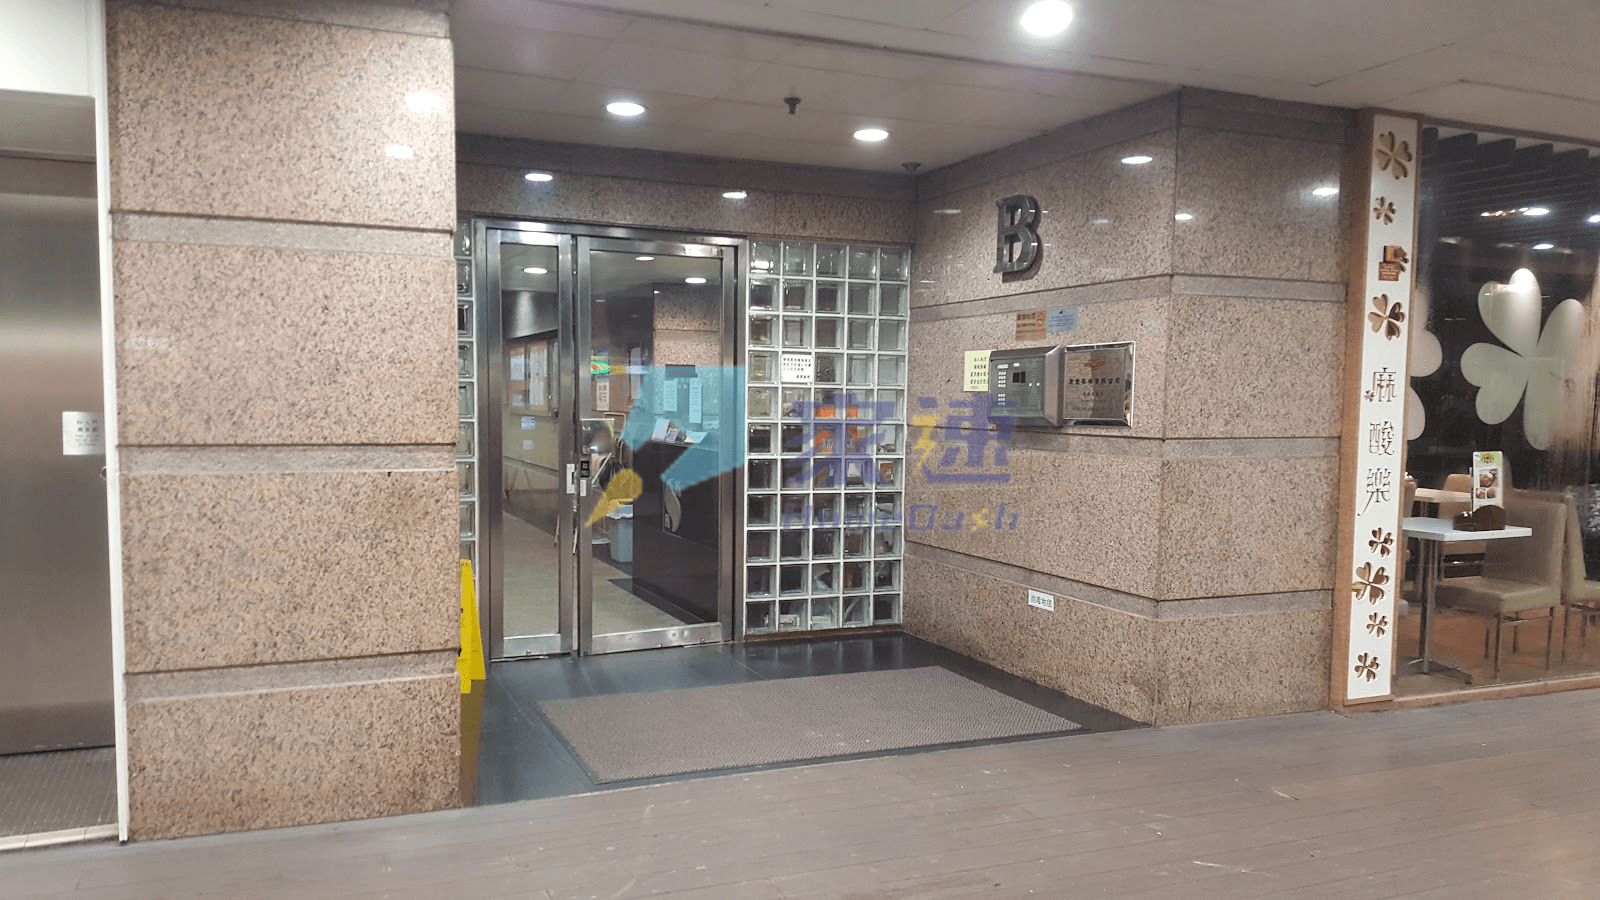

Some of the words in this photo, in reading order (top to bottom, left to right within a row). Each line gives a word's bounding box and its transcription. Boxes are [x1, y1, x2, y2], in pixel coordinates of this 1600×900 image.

[993, 195, 1041, 279] B
[1357, 367, 1397, 516] 麻酸樂
